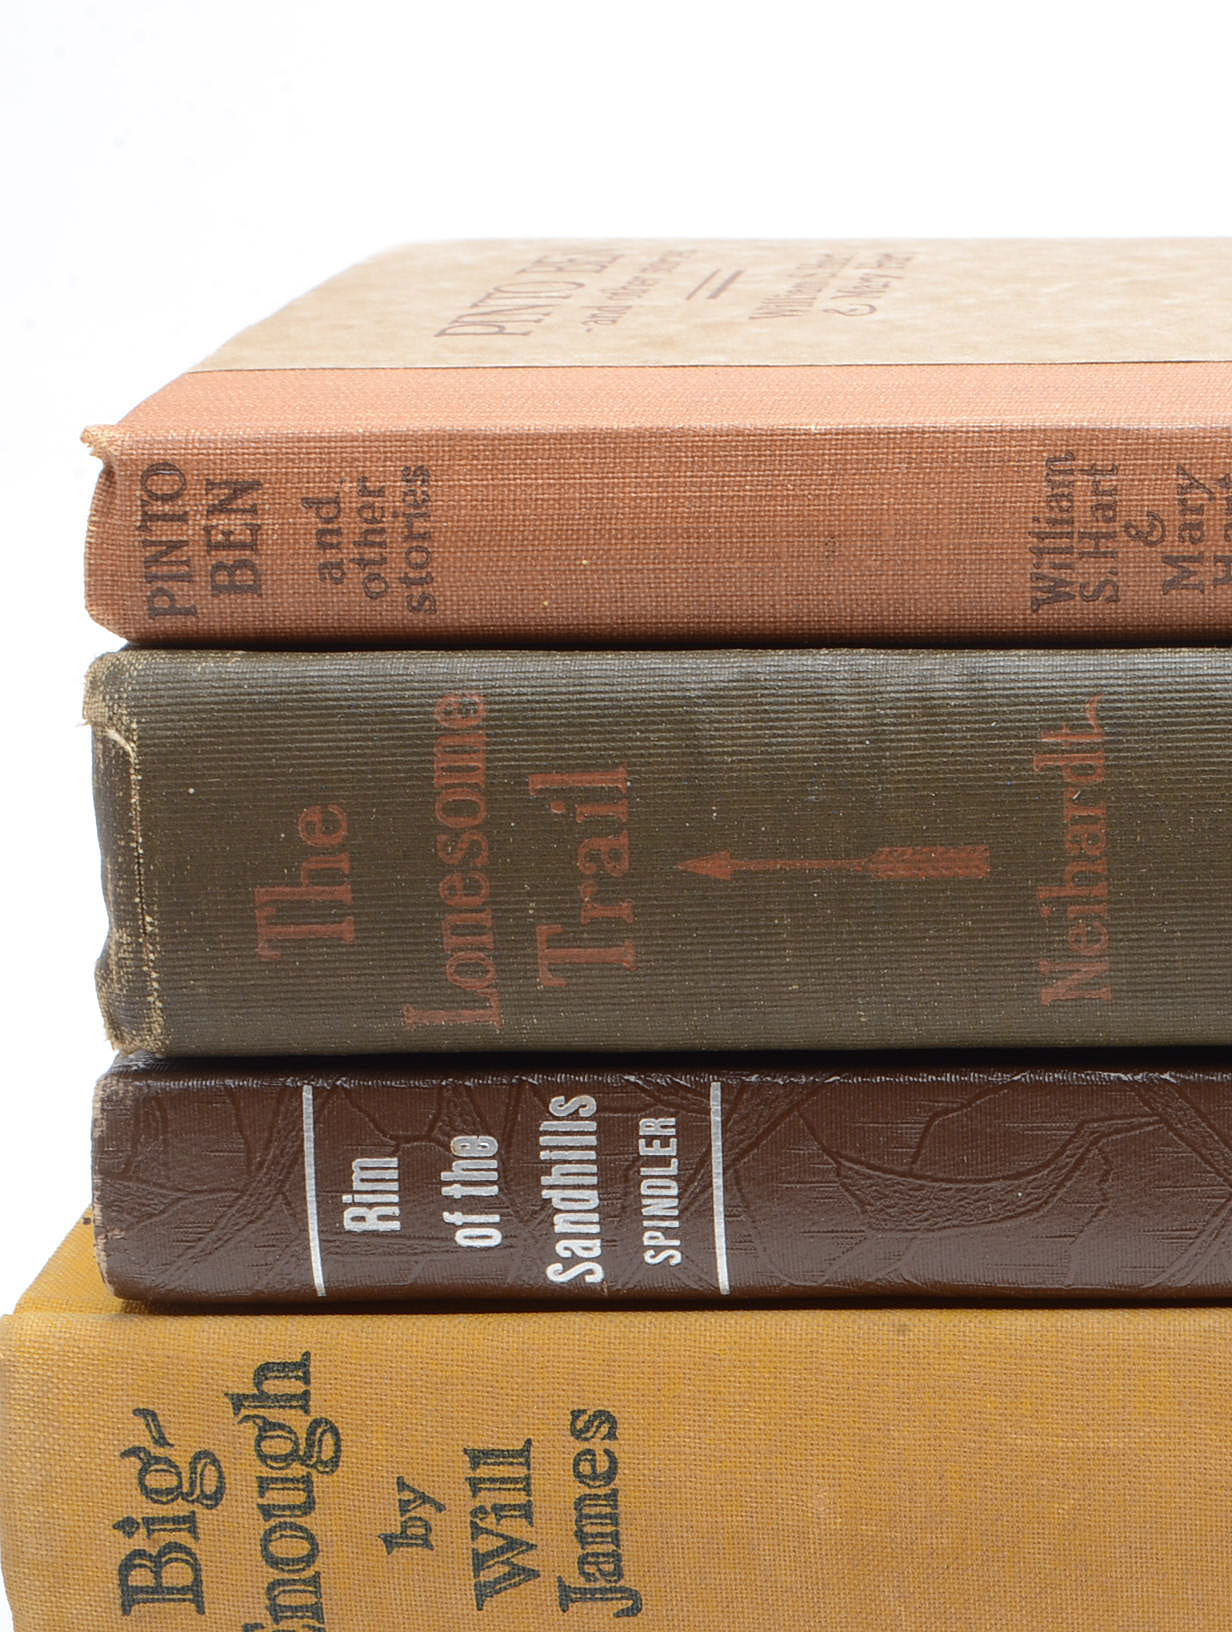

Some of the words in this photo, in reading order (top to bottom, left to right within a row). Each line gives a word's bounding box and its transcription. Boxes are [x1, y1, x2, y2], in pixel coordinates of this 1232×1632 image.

[433, 280, 586, 337] PINTO
[138, 461, 199, 620] PINTO
[204, 478, 263, 599] BEN
[301, 494, 346, 585] and
[351, 475, 390, 600] other
[401, 464, 438, 616] stories
[1028, 451, 1076, 613] William
[1077, 463, 1119, 559] Hart
[1123, 510, 1167, 547] &
[1162, 463, 1217, 595] Mary
[1078, 568, 1120, 603] S.
[255, 803, 356, 961] The
[402, 692, 504, 1033] Lonesome
[528, 763, 637, 988] Trail
[1032, 693, 1112, 1005] Neihardt
[342, 1157, 400, 1232] Rim
[440, 1135, 499, 1199] the
[442, 1211, 502, 1248] of
[538, 1094, 605, 1284] Sandhills
[639, 1117, 682, 1267] SPINDLER
[224, 1351, 342, 1632] nough
[378, 1476, 446, 1555] by
[463, 1438, 540, 1611] Will
[557, 1408, 643, 1618] James
